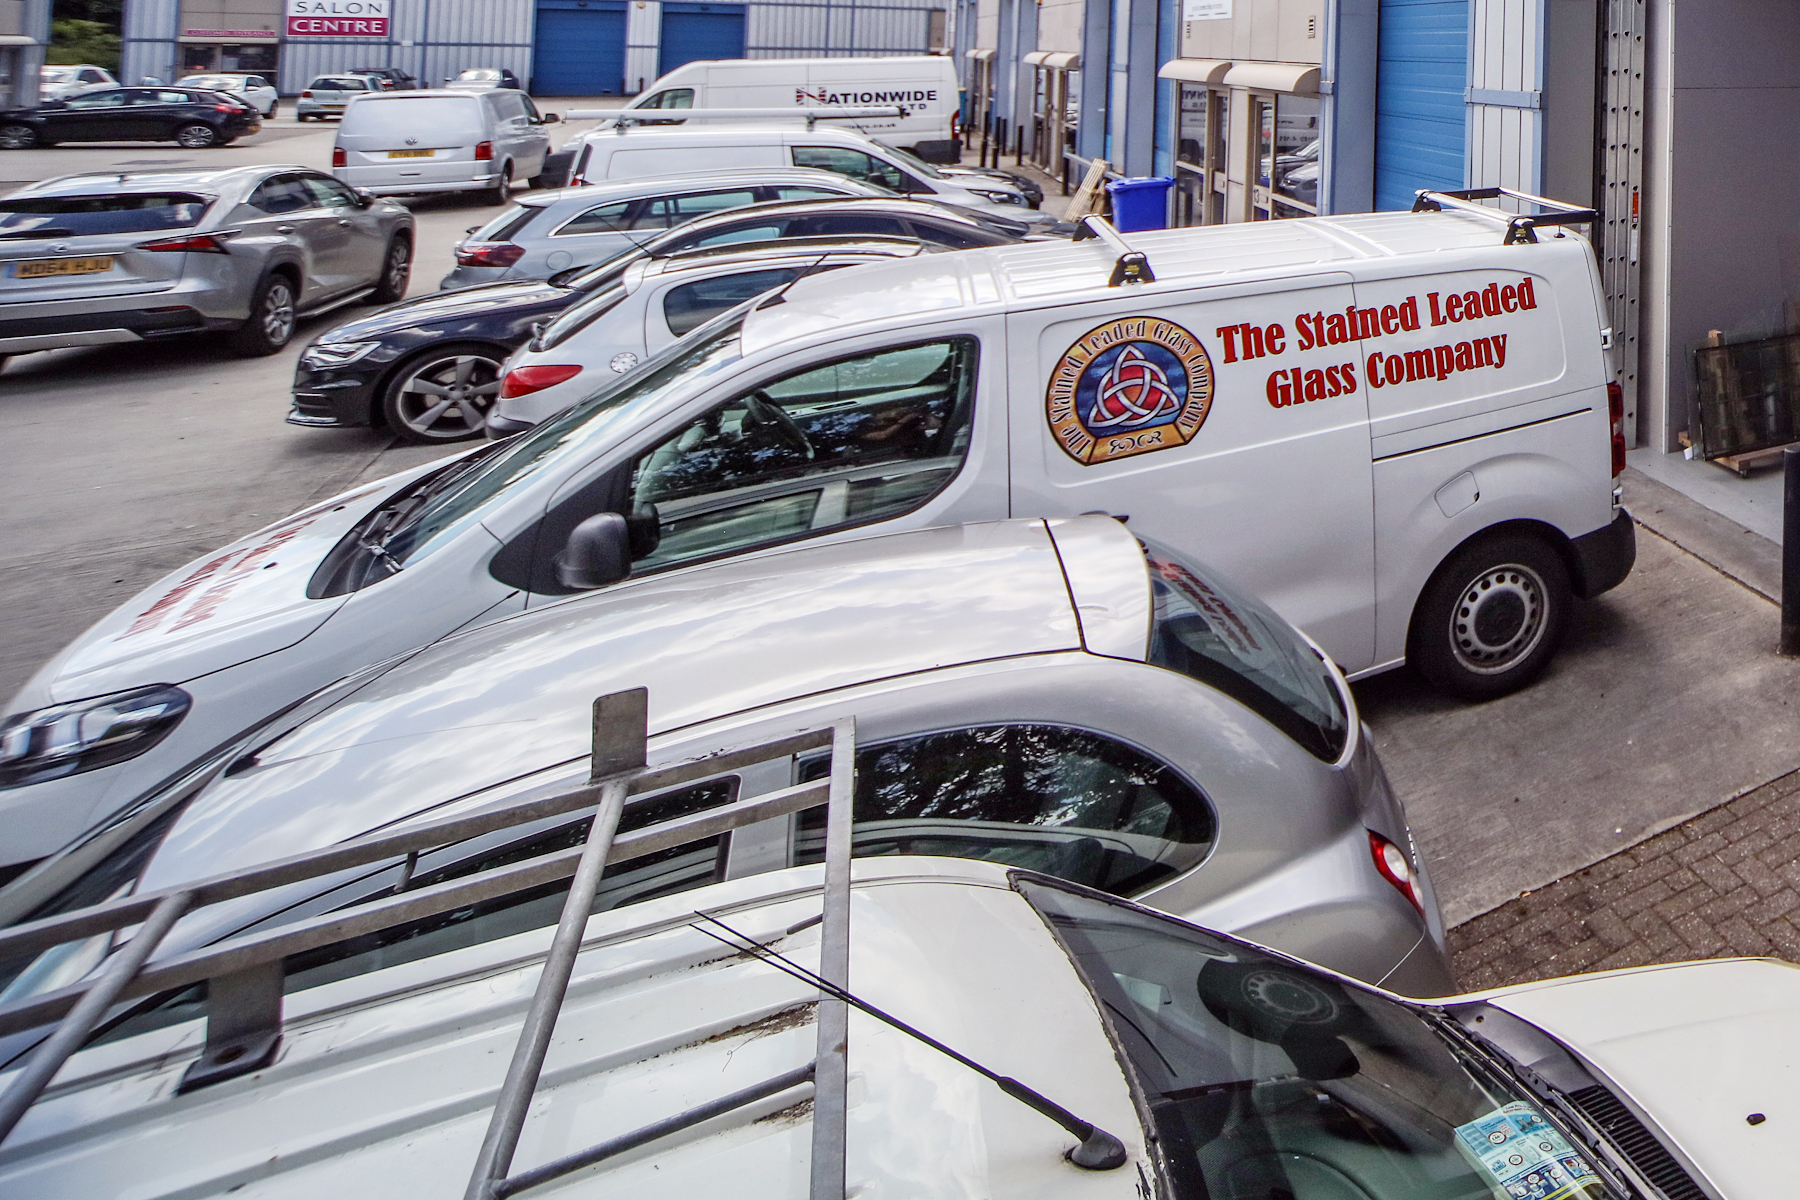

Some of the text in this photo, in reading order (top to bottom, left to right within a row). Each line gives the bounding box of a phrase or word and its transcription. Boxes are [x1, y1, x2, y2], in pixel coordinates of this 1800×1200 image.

[293, 19, 384, 34] CENTRE
[296, 1, 382, 15] SALON
[796, 87, 937, 105] NATIONWIDE
[1216, 277, 1537, 364] The Stained Leaded
[1050, 320, 1209, 457] The Stained Leaded Glass Company
[1266, 333, 1508, 409] Glass Company
